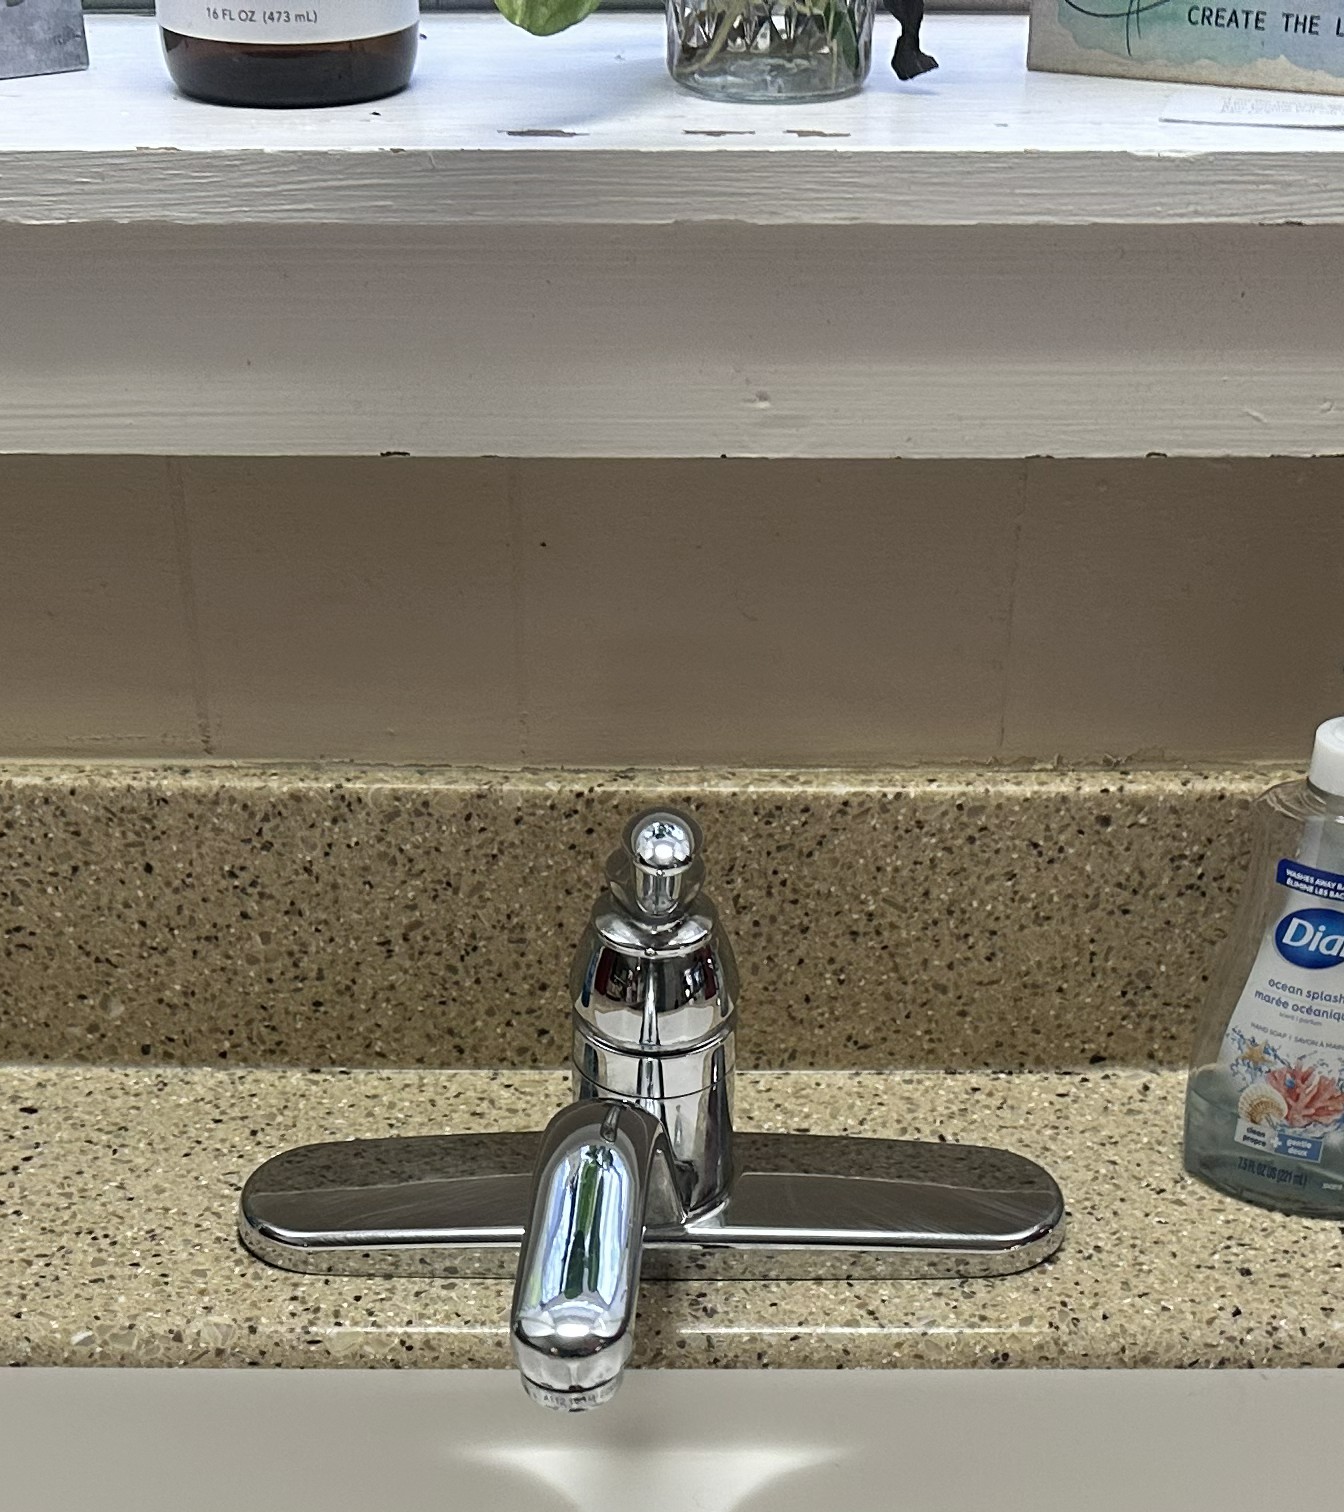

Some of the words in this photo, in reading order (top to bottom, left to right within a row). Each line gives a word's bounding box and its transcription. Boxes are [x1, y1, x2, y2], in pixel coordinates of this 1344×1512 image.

[206, 7, 219, 20] 16
[221, 8, 236, 21] FL
[238, 9, 256, 22] OZ
[262, 10, 291, 24] (473
[294, 10, 318, 24] mL)
[1187, 5, 1267, 31] CREATE
[1282, 12, 1321, 36] THE
[1315, 878, 1337, 890] AWAY
[1268, 978, 1303, 997] ocean
[1254, 989, 1290, 1009] marée
